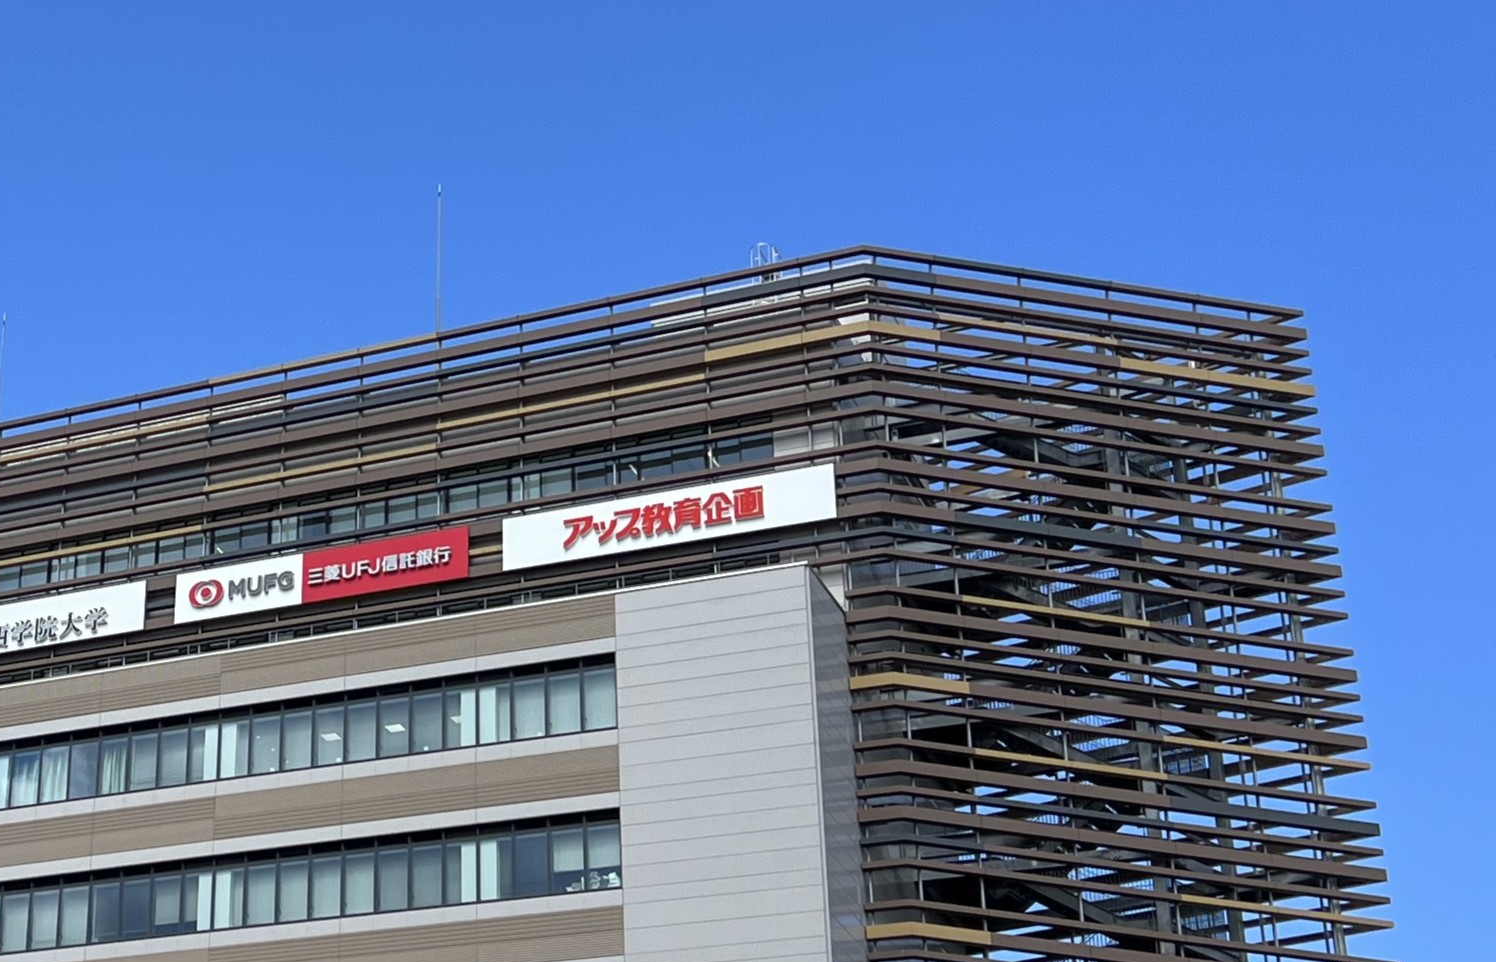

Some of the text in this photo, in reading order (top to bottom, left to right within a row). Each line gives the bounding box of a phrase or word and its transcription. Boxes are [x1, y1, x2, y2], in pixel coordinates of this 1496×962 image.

[563, 486, 764, 549] アップ教育企画
[307, 545, 451, 585] 三菱UFJ信託銀行
[228, 571, 295, 600] MUFG
